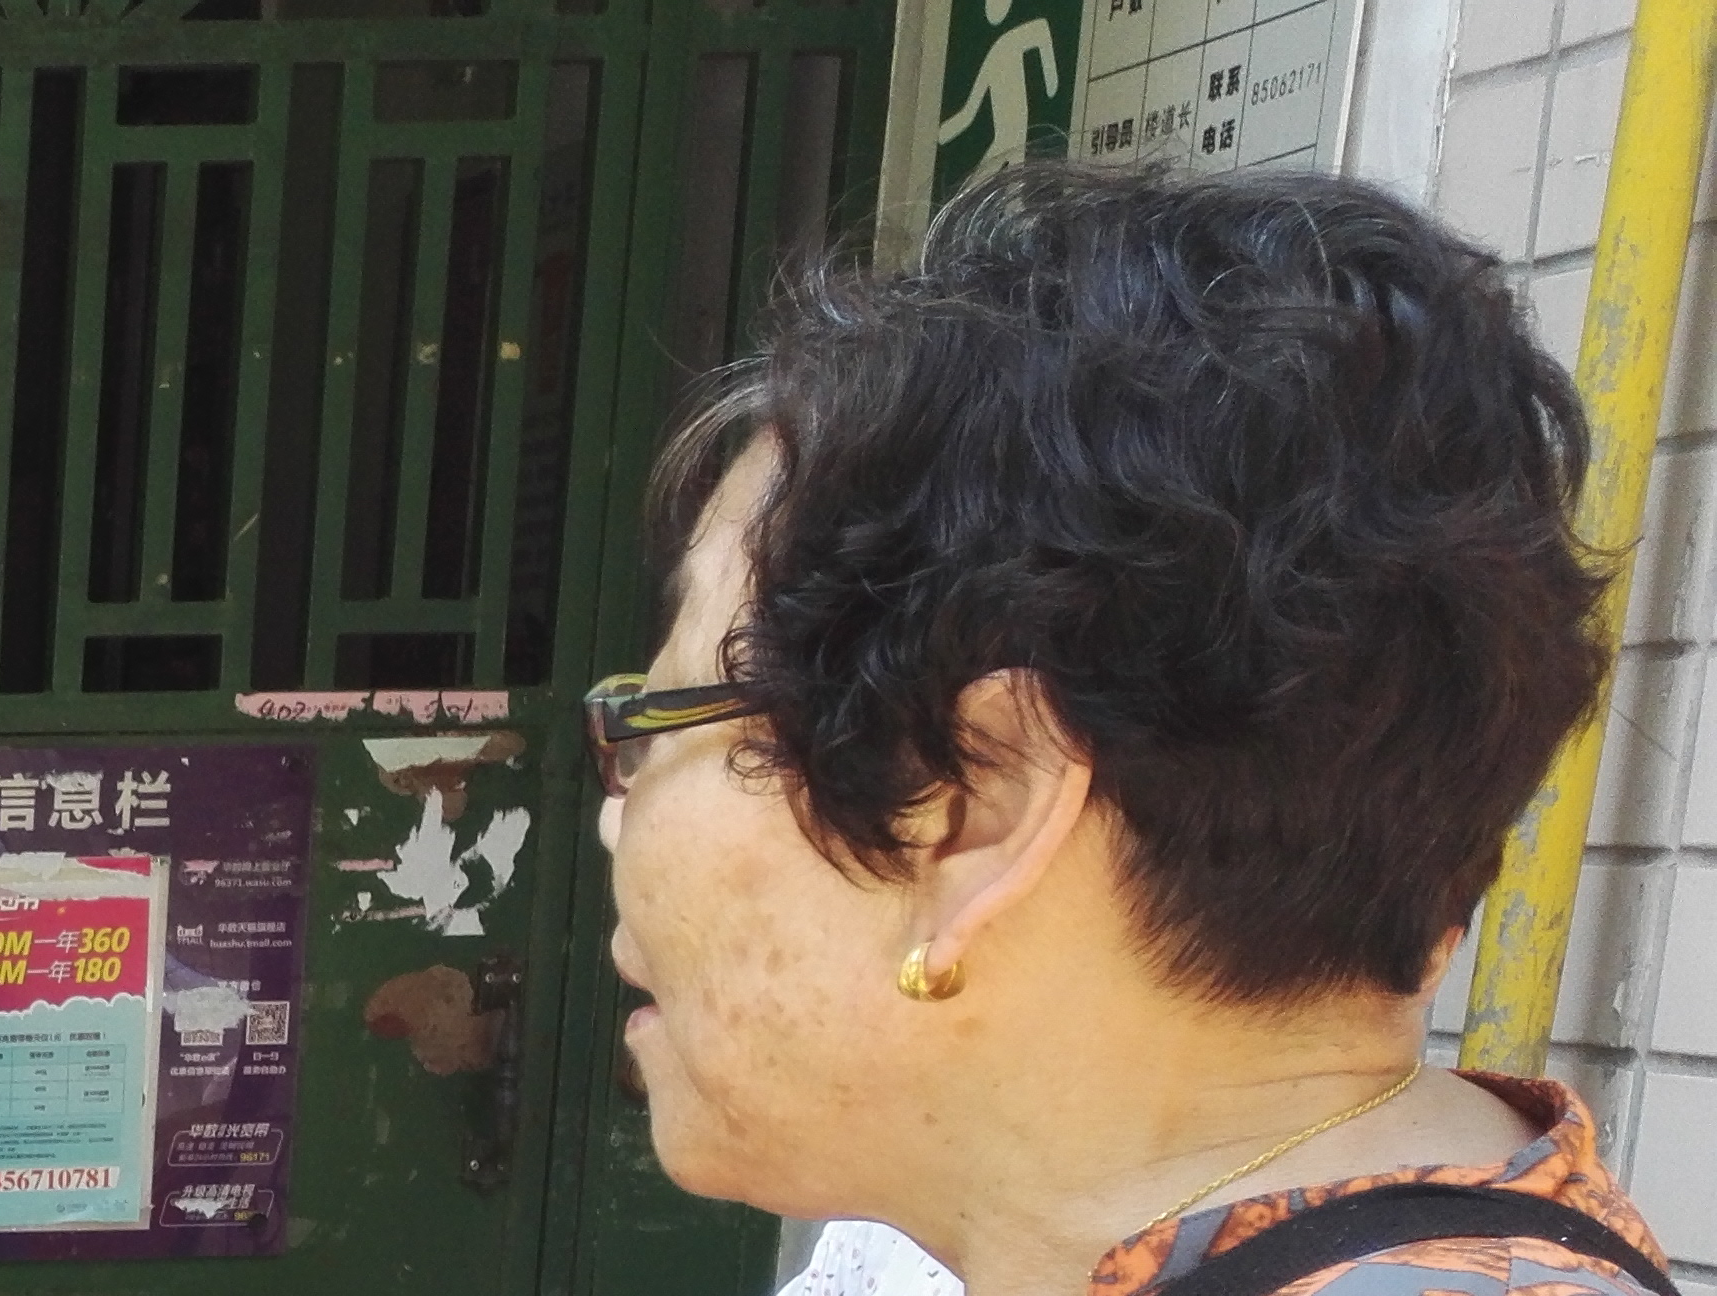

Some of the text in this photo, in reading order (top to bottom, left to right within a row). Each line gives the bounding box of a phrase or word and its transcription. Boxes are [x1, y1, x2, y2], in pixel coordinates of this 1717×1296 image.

[1208, 65, 1241, 102] 联系
[1251, 62, 1322, 106] 85062171
[1091, 119, 1134, 155] 引导员
[1201, 119, 1236, 154] 电话
